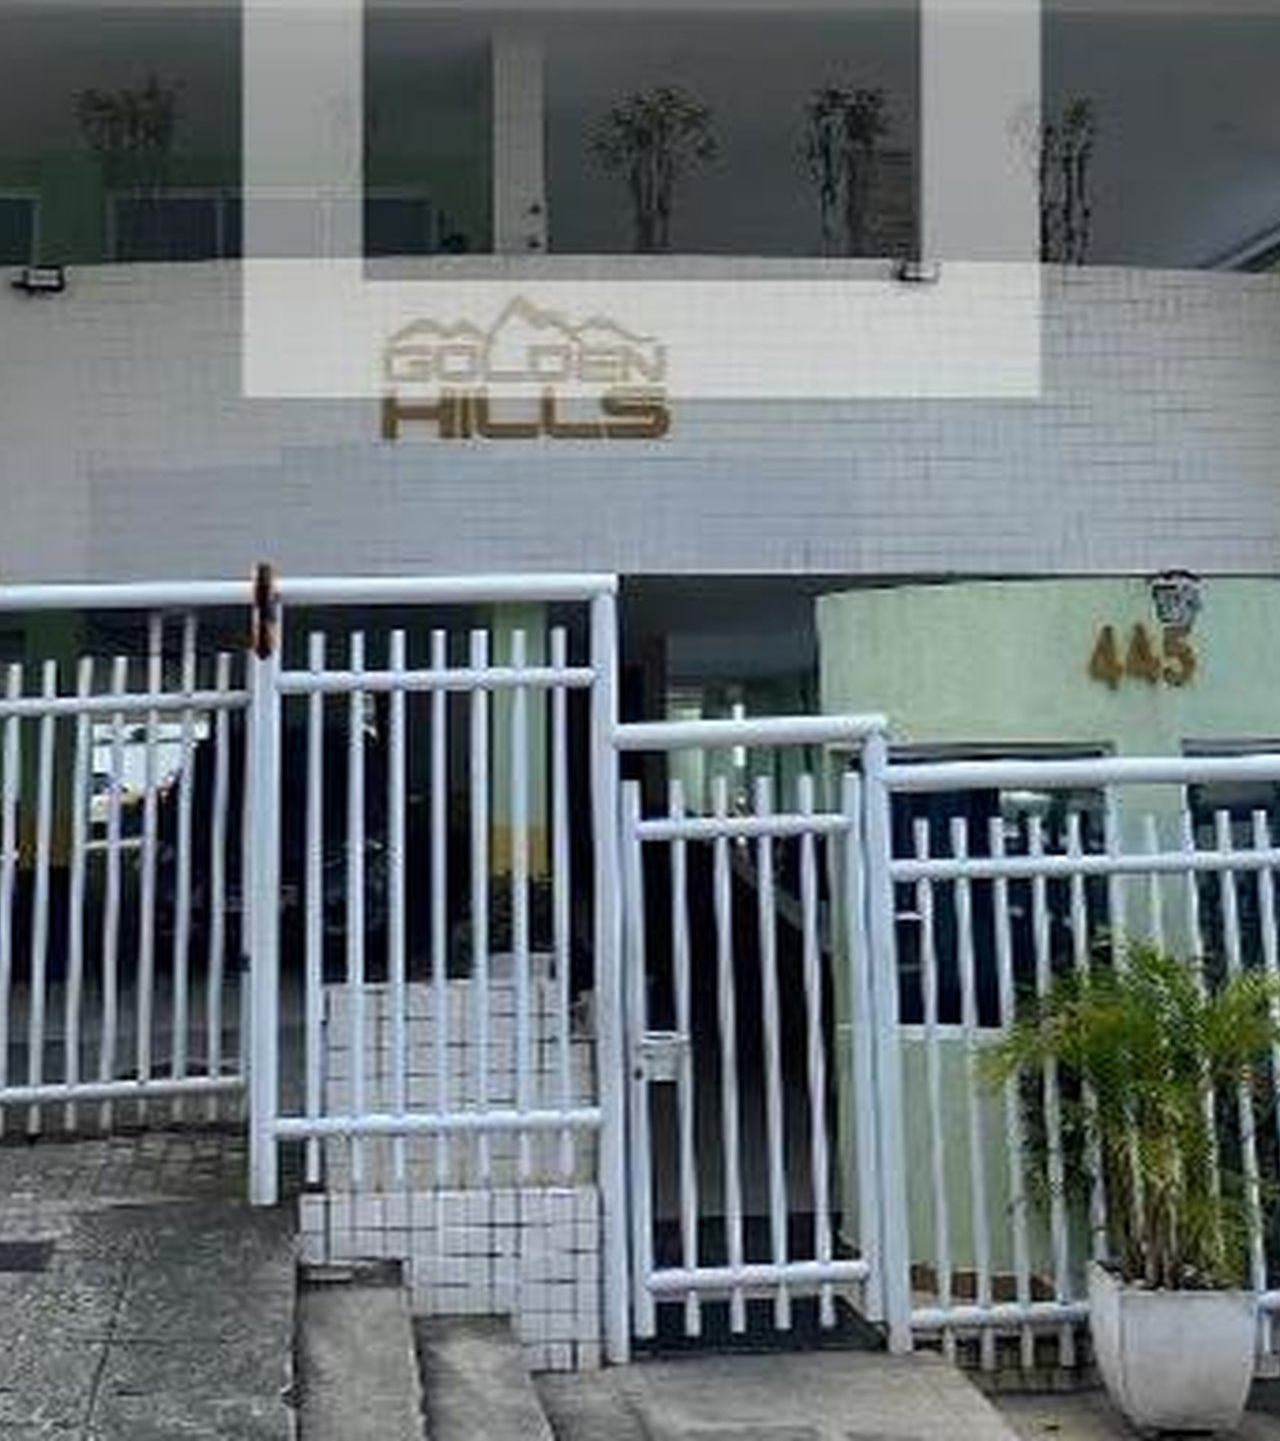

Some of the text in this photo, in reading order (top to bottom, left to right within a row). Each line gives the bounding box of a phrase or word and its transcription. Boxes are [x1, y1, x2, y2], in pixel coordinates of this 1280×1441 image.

[385, 343, 668, 383] GOLDEN
[381, 387, 671, 440] HILLS
[1089, 623, 1196, 690] 445
